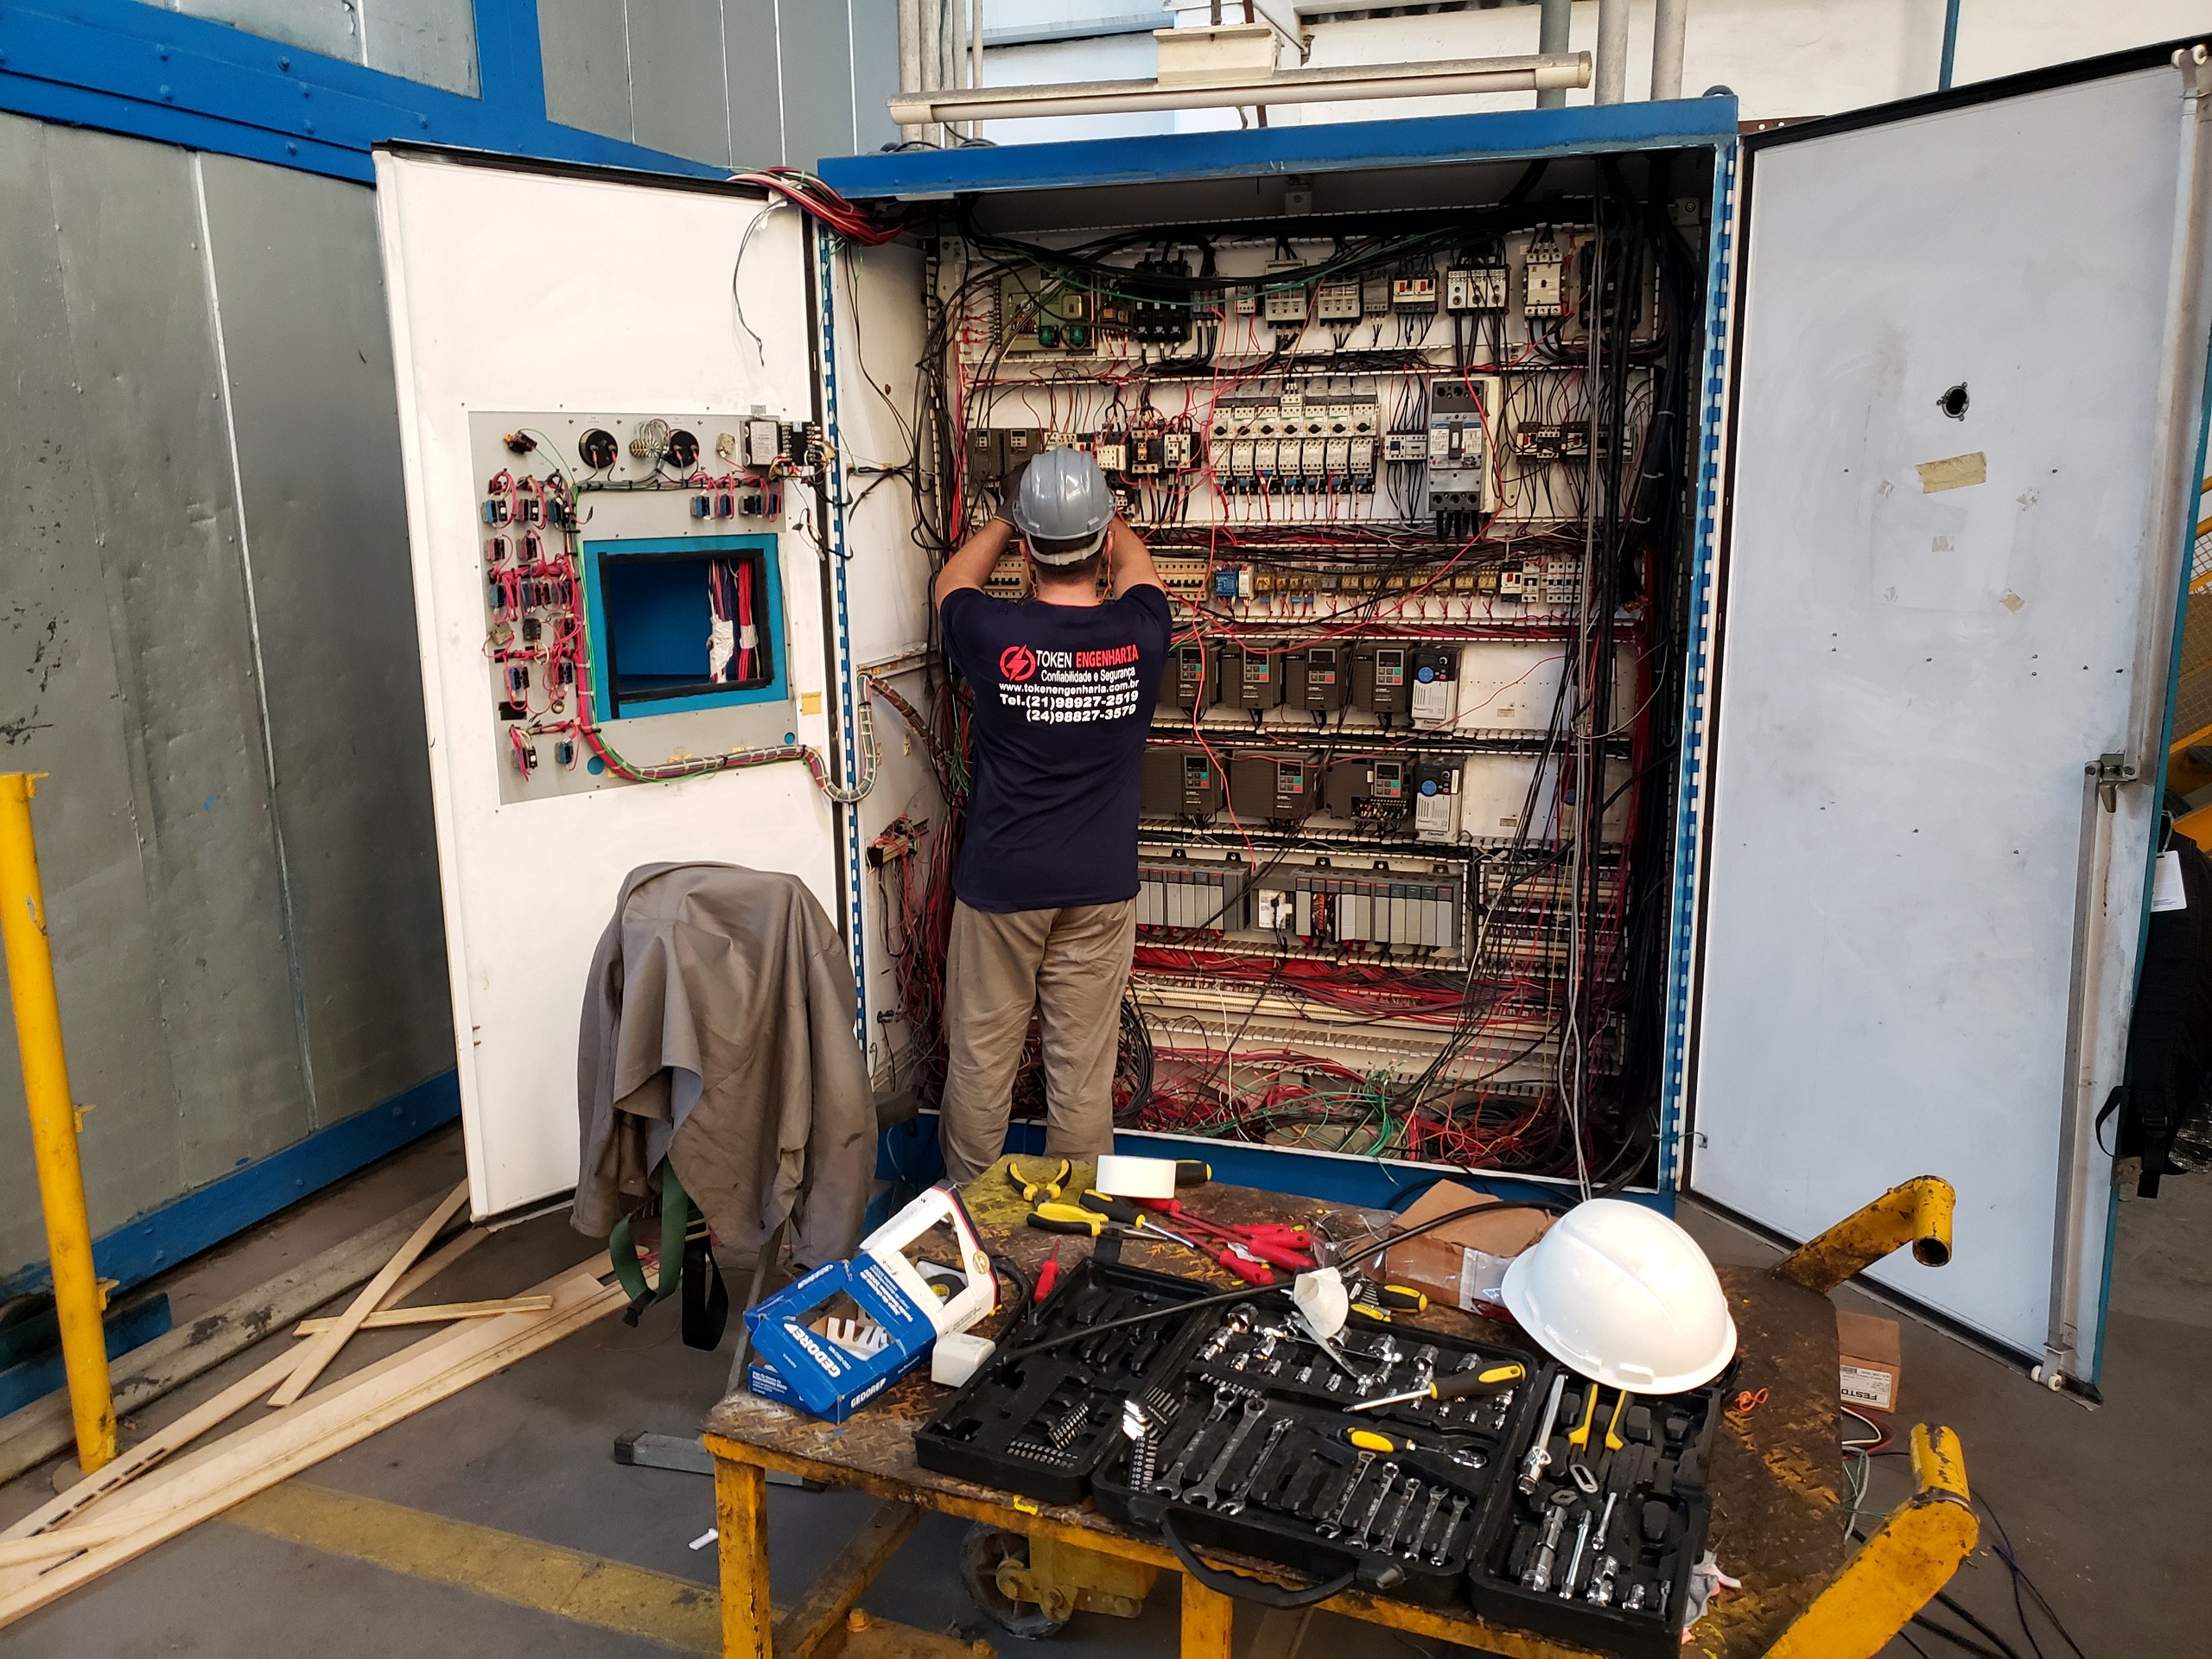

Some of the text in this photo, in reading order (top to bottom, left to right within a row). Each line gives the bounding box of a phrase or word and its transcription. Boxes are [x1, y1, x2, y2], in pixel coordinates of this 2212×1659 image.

[1036, 644, 1139, 668] TOKEN ENGENHARIA
[1041, 666, 1135, 683] Confiabilidade e Segurança
[999, 679, 1140, 696] www.tokenengenharia.com.br
[1027, 704, 1136, 724] (24)98827-3579
[791, 1328, 841, 1378] GEDORE
[851, 1379, 884, 1408] GEDORE
[1841, 1389, 1877, 1401] FESTO
